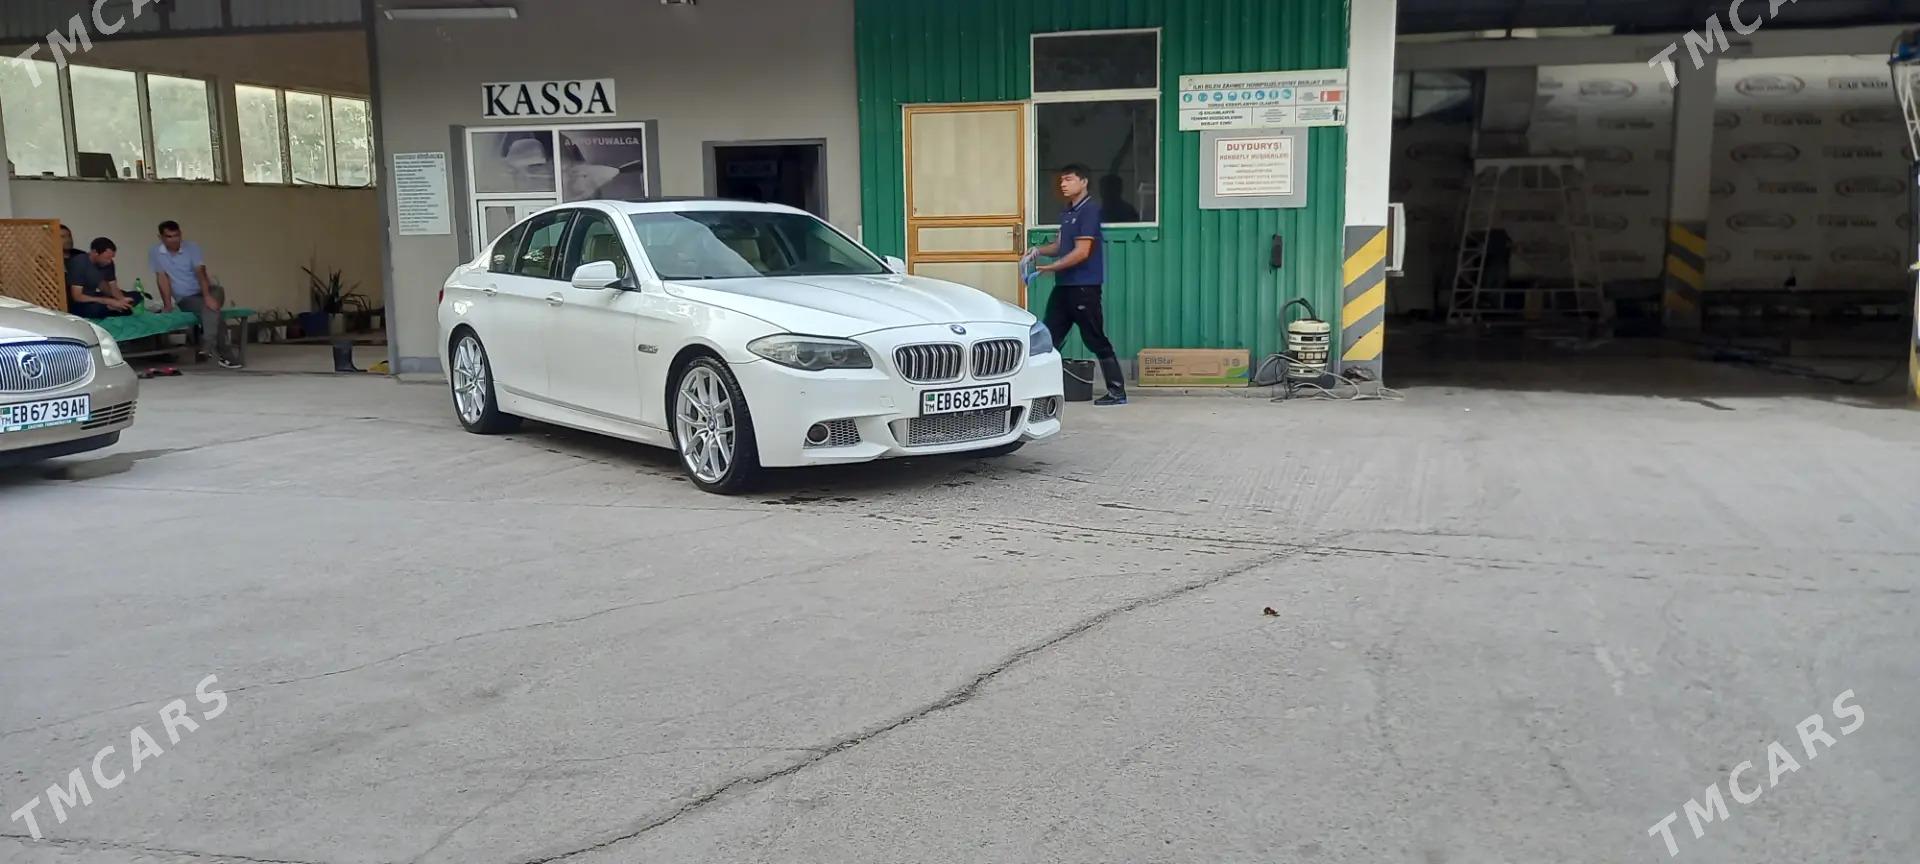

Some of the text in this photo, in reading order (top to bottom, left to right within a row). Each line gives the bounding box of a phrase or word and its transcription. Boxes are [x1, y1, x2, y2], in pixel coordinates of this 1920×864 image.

[482, 81, 615, 116] KASSA
[925, 404, 935, 412] TM
[1, 417, 12, 425] TM
